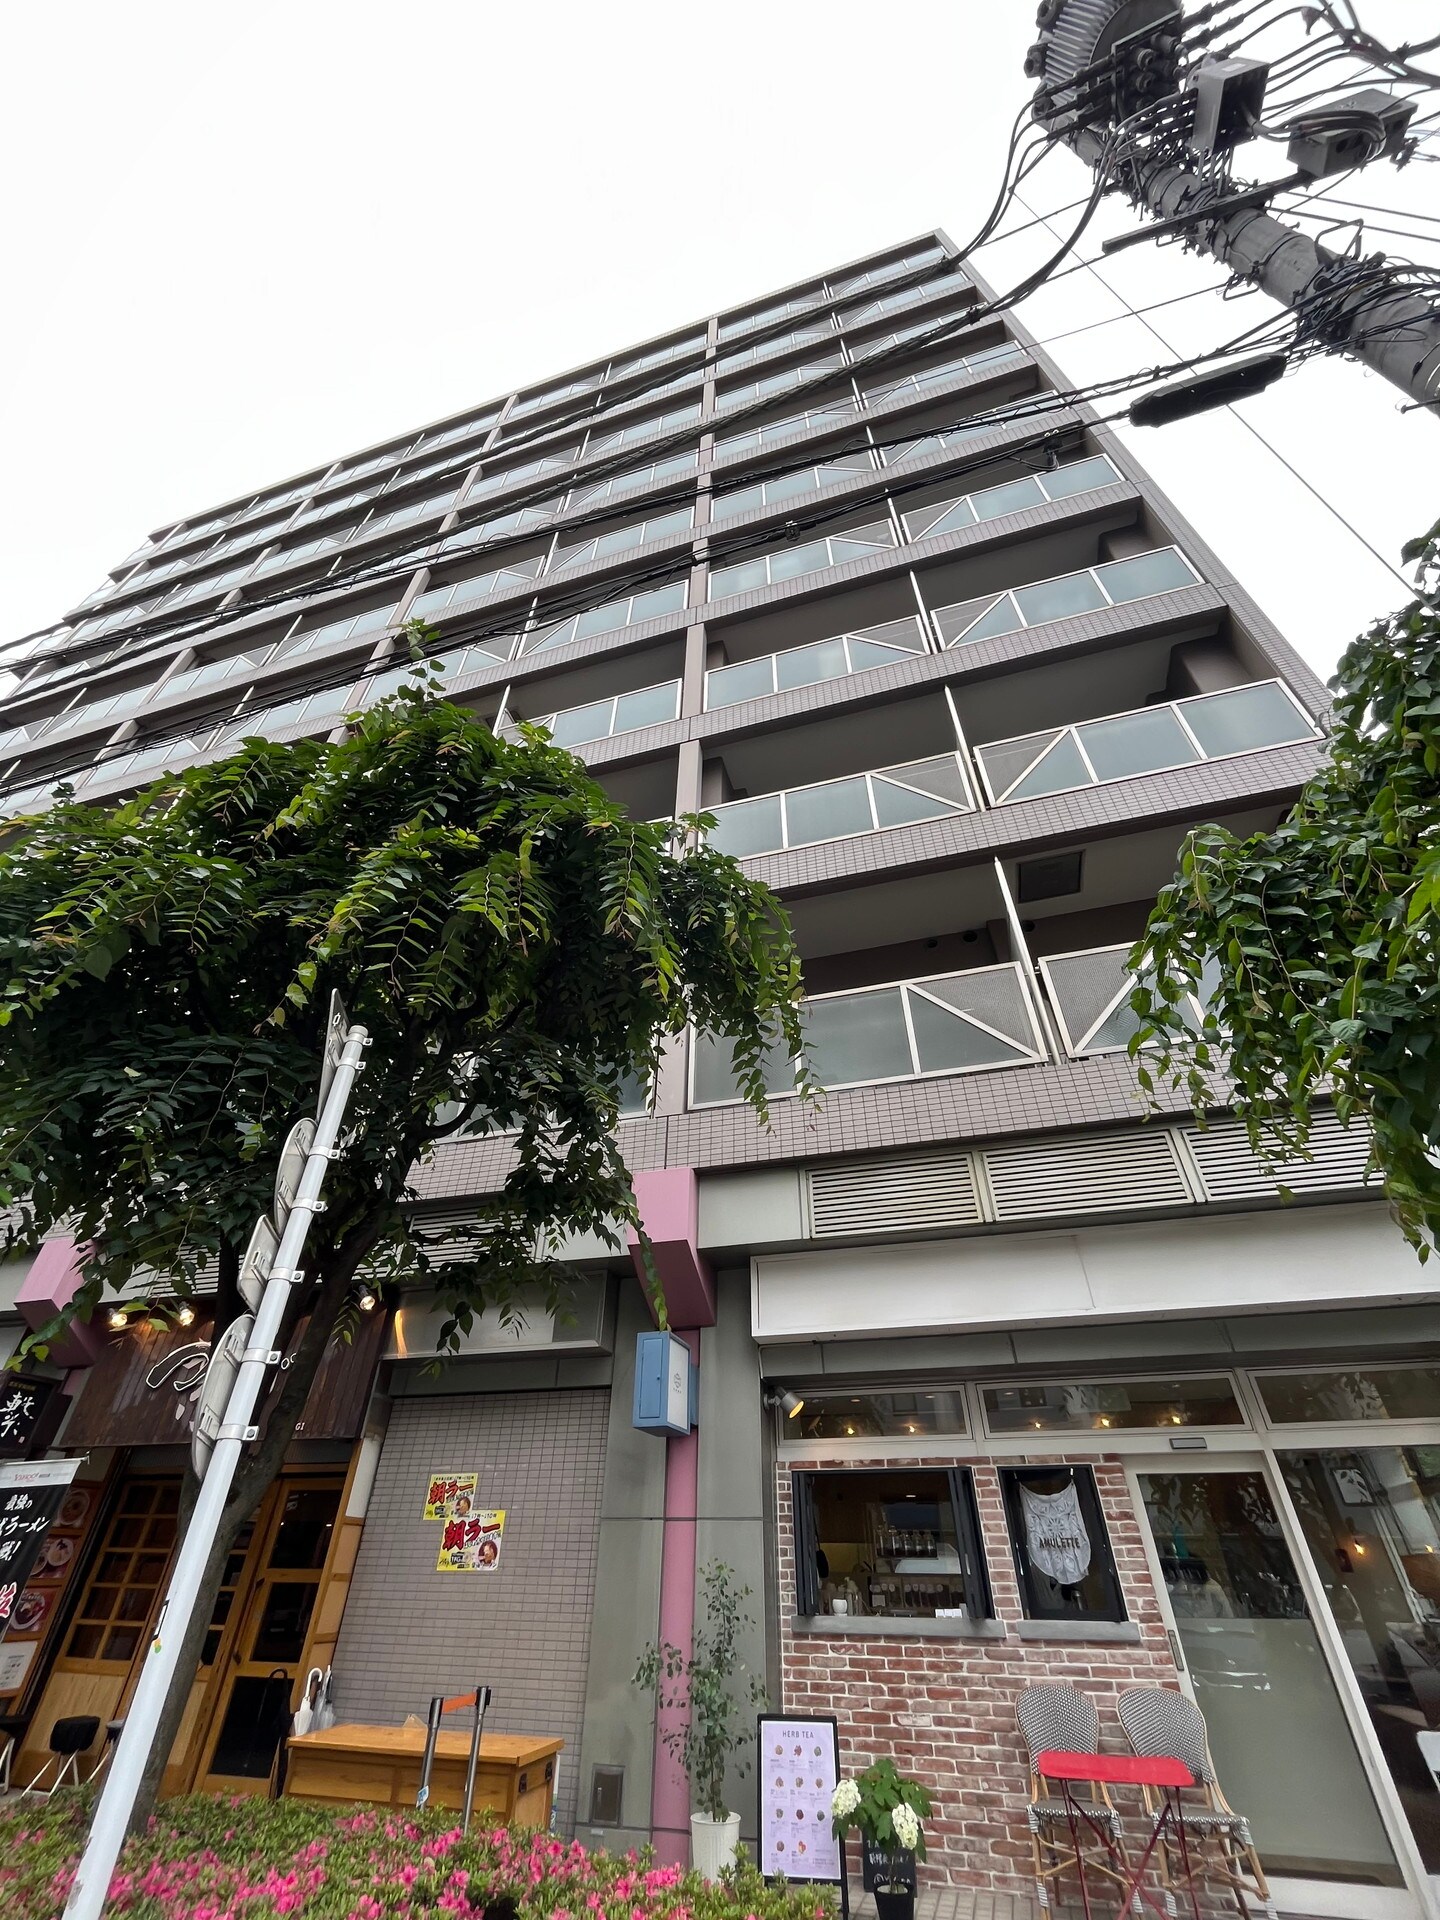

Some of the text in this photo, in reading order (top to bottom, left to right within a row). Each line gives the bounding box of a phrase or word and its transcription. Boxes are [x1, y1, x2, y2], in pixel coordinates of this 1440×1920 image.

[428, 1480, 474, 1505] 朝ラー
[442, 1518, 501, 1551] 朝ラー
[1039, 1537, 1080, 1549] AMULETTE
[782, 1730, 814, 1739] HERB TEA
